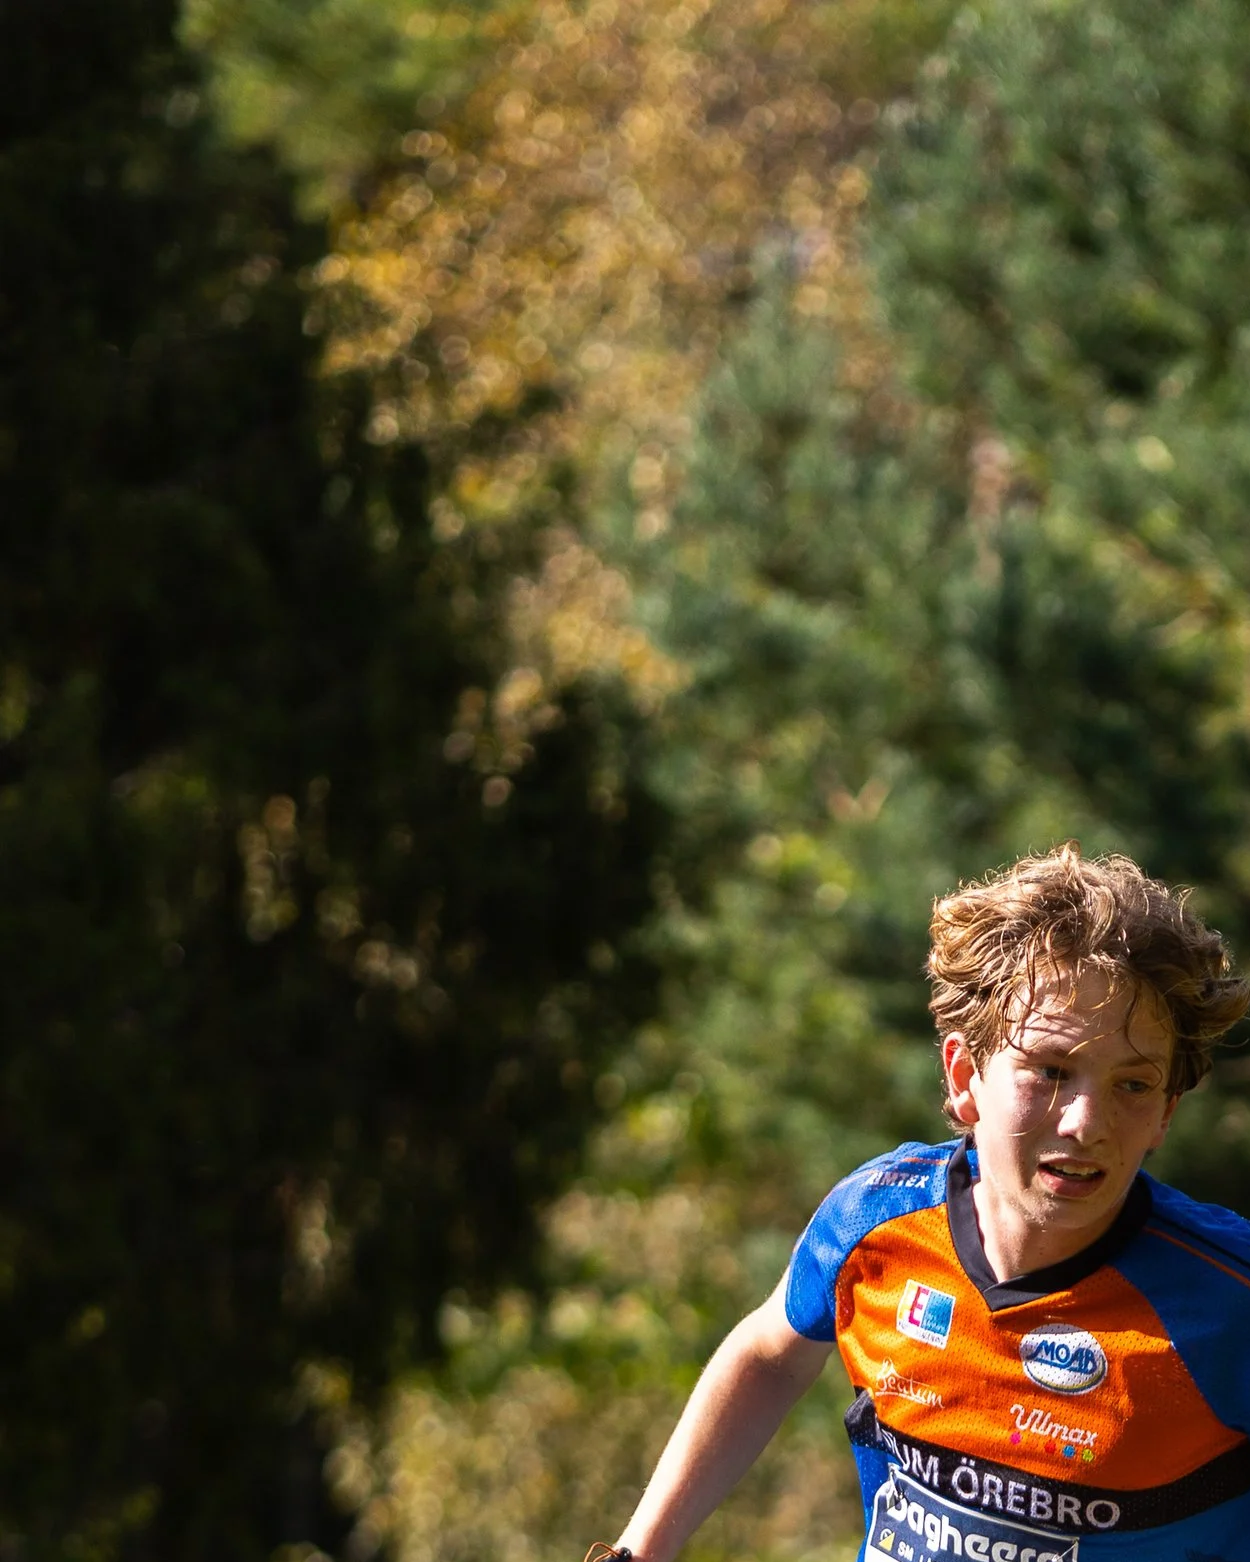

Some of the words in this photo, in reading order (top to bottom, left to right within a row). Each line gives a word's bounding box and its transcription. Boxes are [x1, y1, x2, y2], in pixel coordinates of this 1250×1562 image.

[1025, 1339, 1098, 1375] MOAB
[1010, 1403, 1098, 1447] Ullmax
[951, 1457, 1121, 1529] ÖREBRO
[897, 1540, 914, 1562] SM
